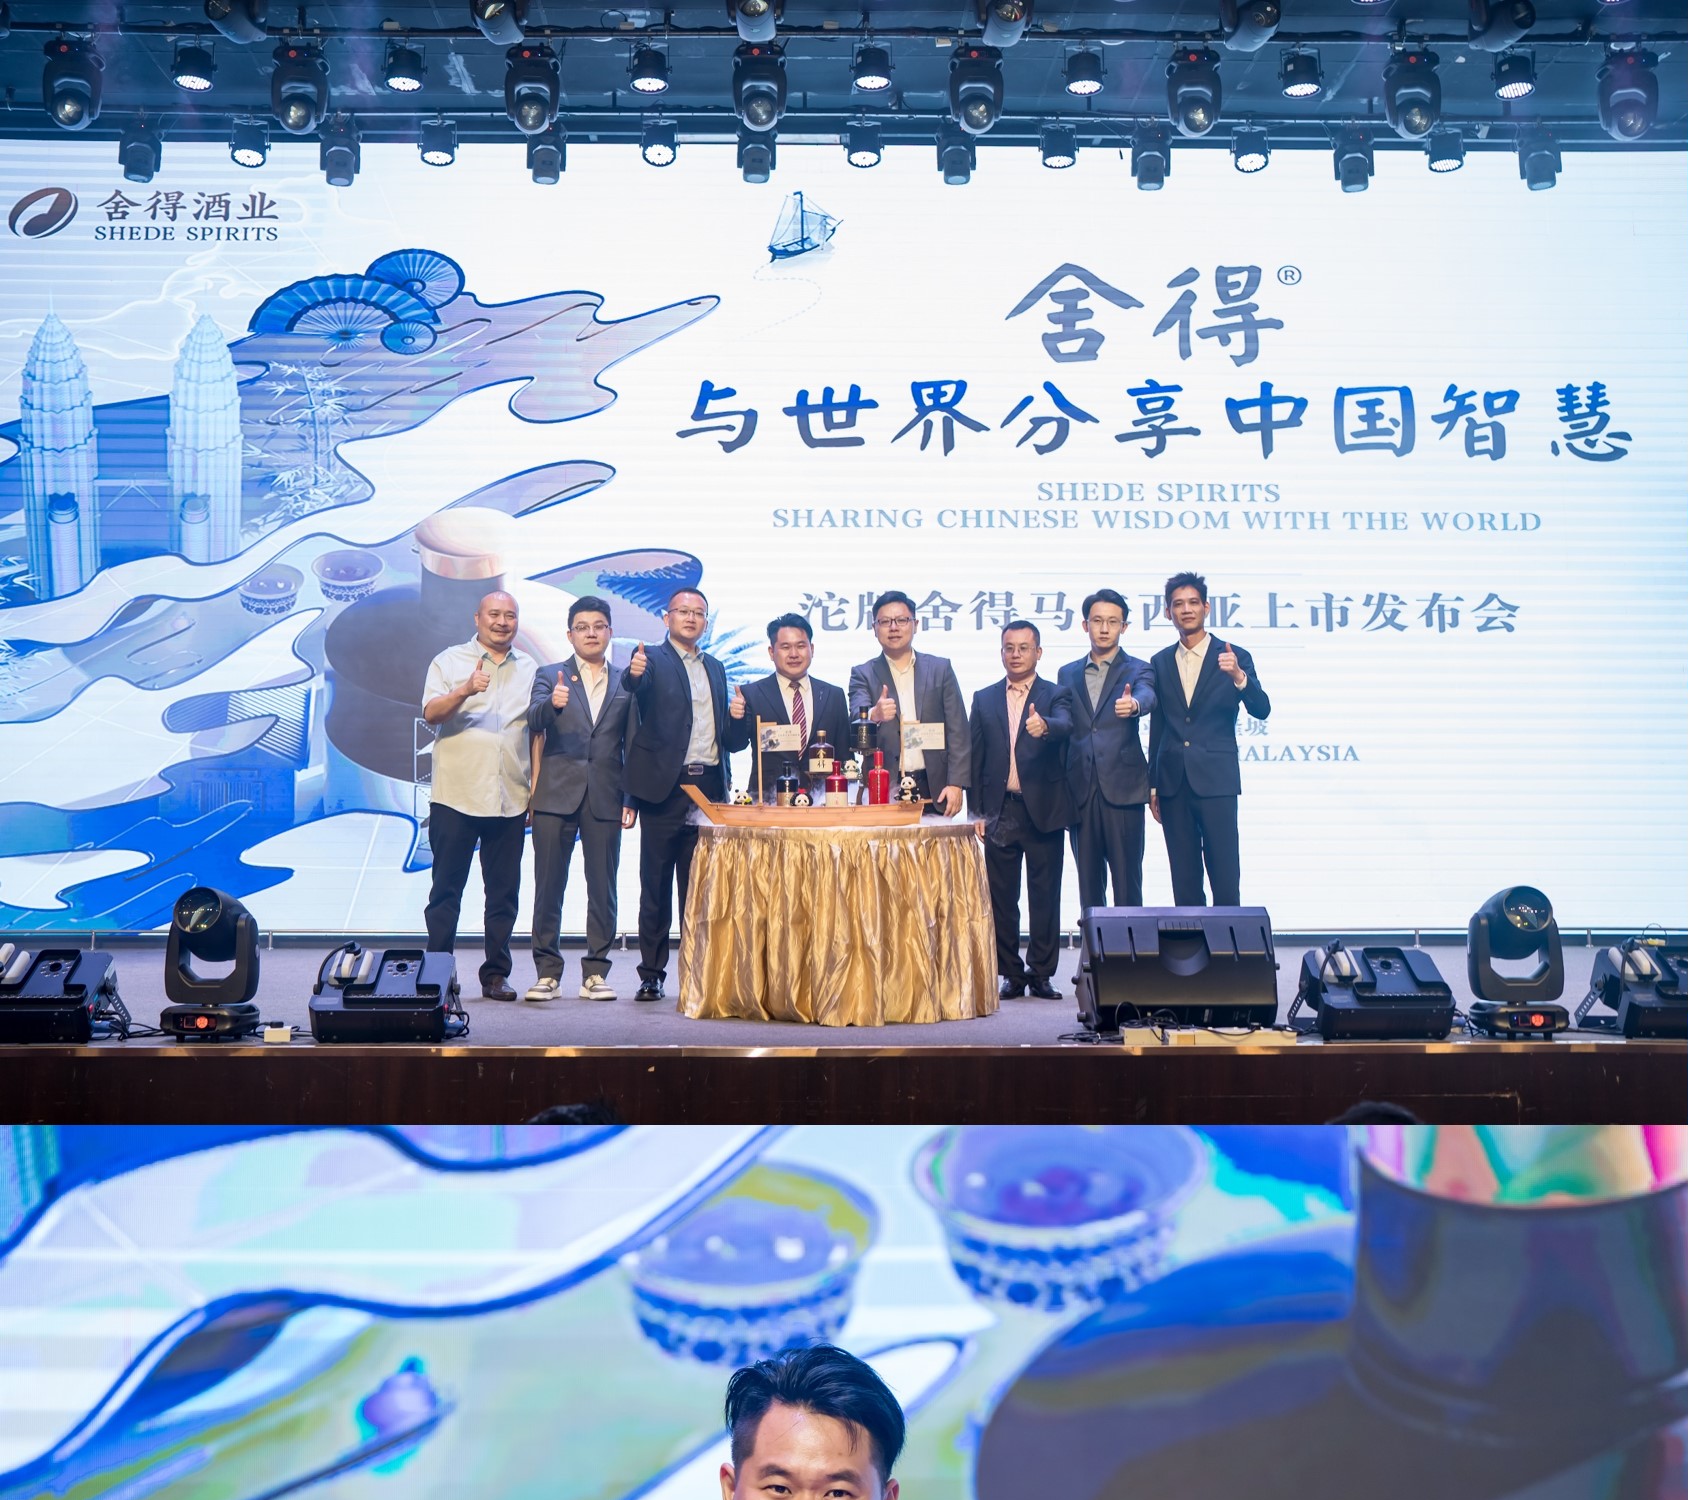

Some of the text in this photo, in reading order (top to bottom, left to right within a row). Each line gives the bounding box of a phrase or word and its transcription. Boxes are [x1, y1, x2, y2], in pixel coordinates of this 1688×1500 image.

[96, 189, 279, 222] 舍得酒业
[94, 226, 278, 242] SHEDE SPIRITS
[676, 379, 1633, 463] 与世界分享中国智慧
[1037, 482, 1281, 503] SHEDE SPIRITS
[772, 508, 1542, 532] SHARING CHINESE WISDOM WITH THE WORLD
